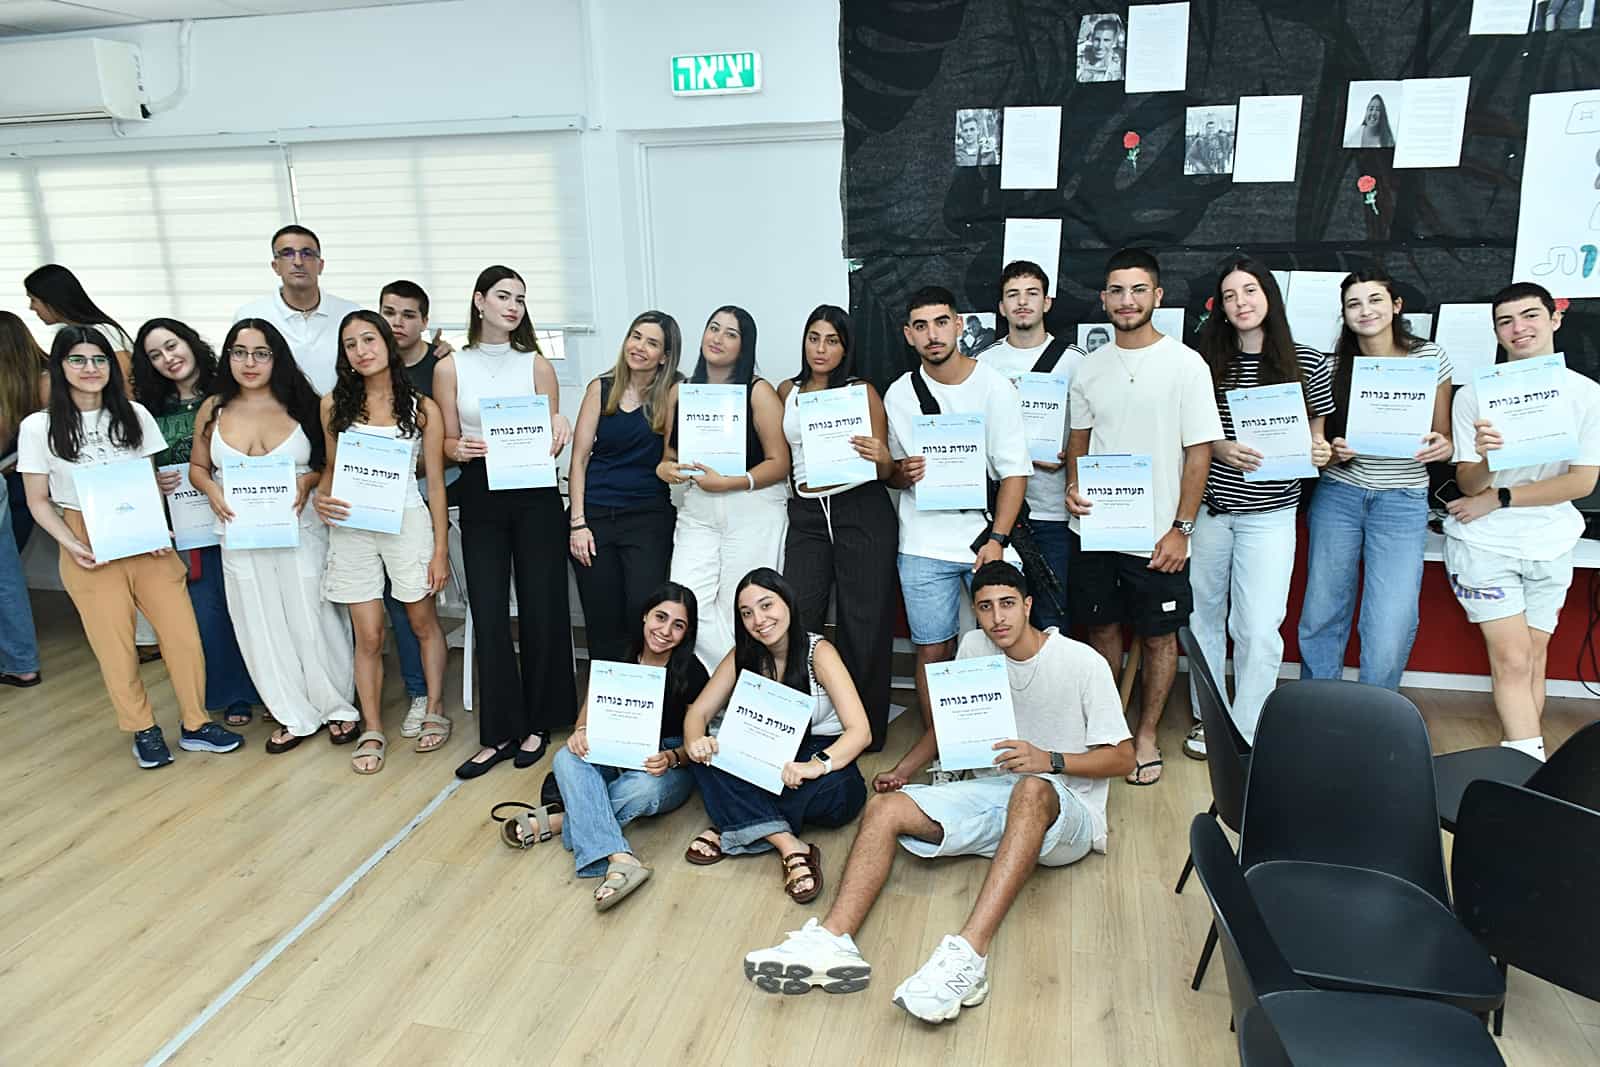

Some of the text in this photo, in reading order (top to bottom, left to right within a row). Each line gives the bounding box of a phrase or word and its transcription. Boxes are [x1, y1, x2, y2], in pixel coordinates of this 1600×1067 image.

[677, 53, 751, 89] יציאה
[1359, 390, 1426, 401] תעודת בגרות
[1488, 389, 1560, 409] תעודת בגרות
[1032, 401, 1059, 411] תעודת
[685, 413, 739, 422] תדת בגרות
[808, 416, 863, 432] תעודת בגרות
[1240, 415, 1299, 429] תעודת בגרות
[489, 425, 544, 437] תעודת בגרות
[921, 444, 978, 454] תעודת בגרות
[343, 464, 400, 481] תעודת בגרות
[173, 488, 199, 501] בגרות
[232, 485, 288, 495] תעודת בגרות
[1087, 487, 1145, 496] תעודת בגרות
[596, 695, 655, 710] תעודת בגרות
[939, 691, 1003, 707] תעודת בגרות
[735, 705, 764, 723] בגרות
[764, 717, 796, 735] תעודת
